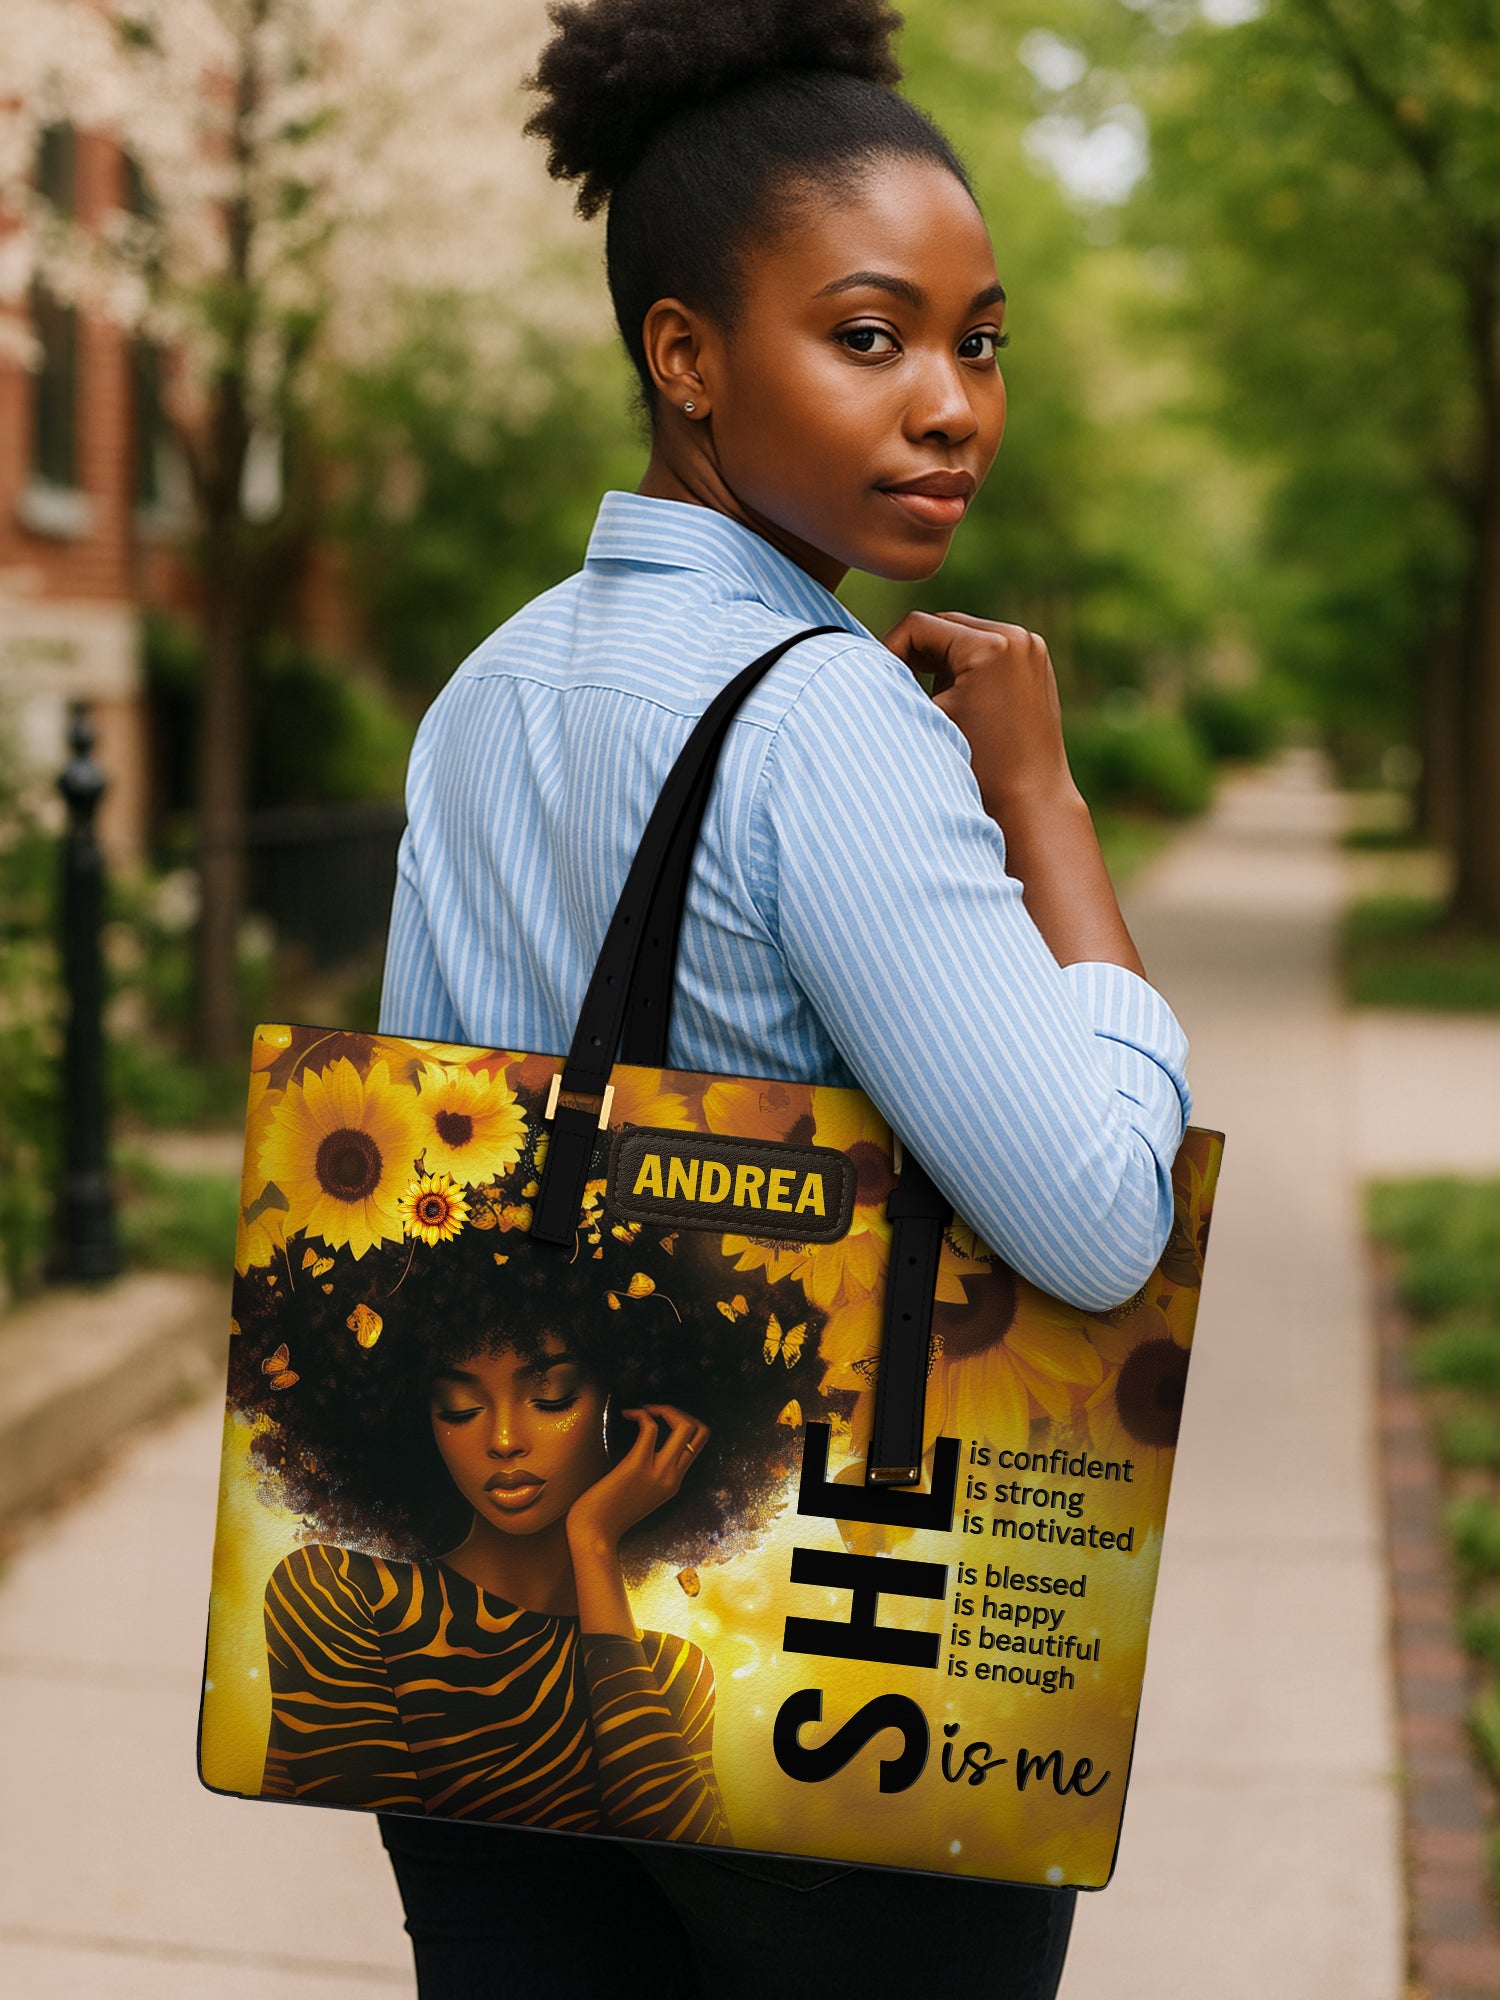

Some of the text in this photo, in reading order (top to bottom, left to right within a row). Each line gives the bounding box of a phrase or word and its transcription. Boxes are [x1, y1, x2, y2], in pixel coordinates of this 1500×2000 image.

[632, 1154, 826, 1217] ANDREA
[969, 1441, 1134, 1483] is confident
[966, 1475, 1085, 1518] is strong
[962, 1509, 1134, 1552] is motivated
[957, 1562, 1087, 1598] is blessed
[773, 1421, 962, 1794] SHE
[953, 1593, 1065, 1631] is happy
[950, 1623, 1100, 1662] is beautiful
[947, 1654, 1075, 1694] is enough
[941, 1722, 1111, 1796] is me
